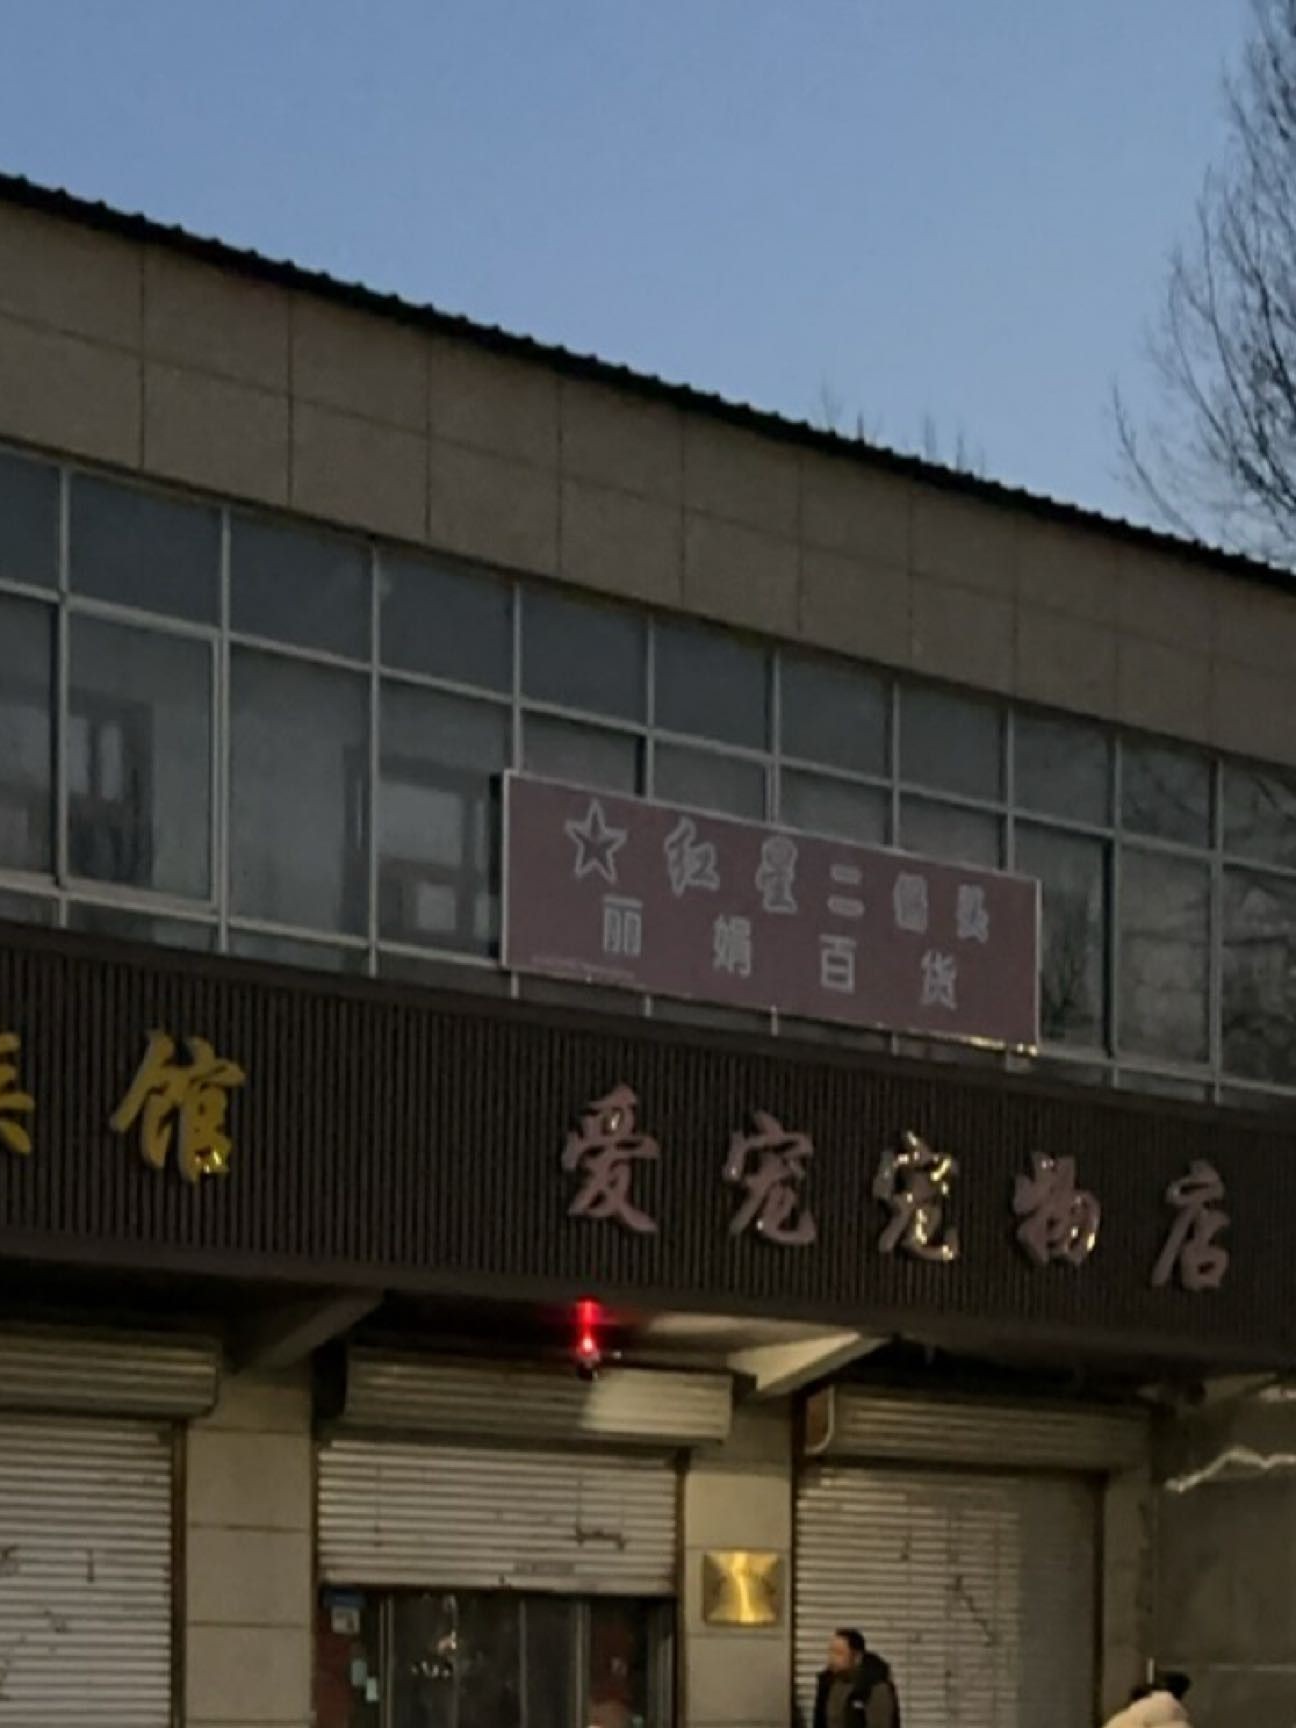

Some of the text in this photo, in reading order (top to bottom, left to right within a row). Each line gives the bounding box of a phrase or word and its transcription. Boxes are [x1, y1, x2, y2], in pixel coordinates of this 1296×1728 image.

[664, 815, 990, 944] 红星二
[603, 894, 959, 1010] 丽娟百货
[561, 1081, 1231, 1293] 爱宠宠物店
